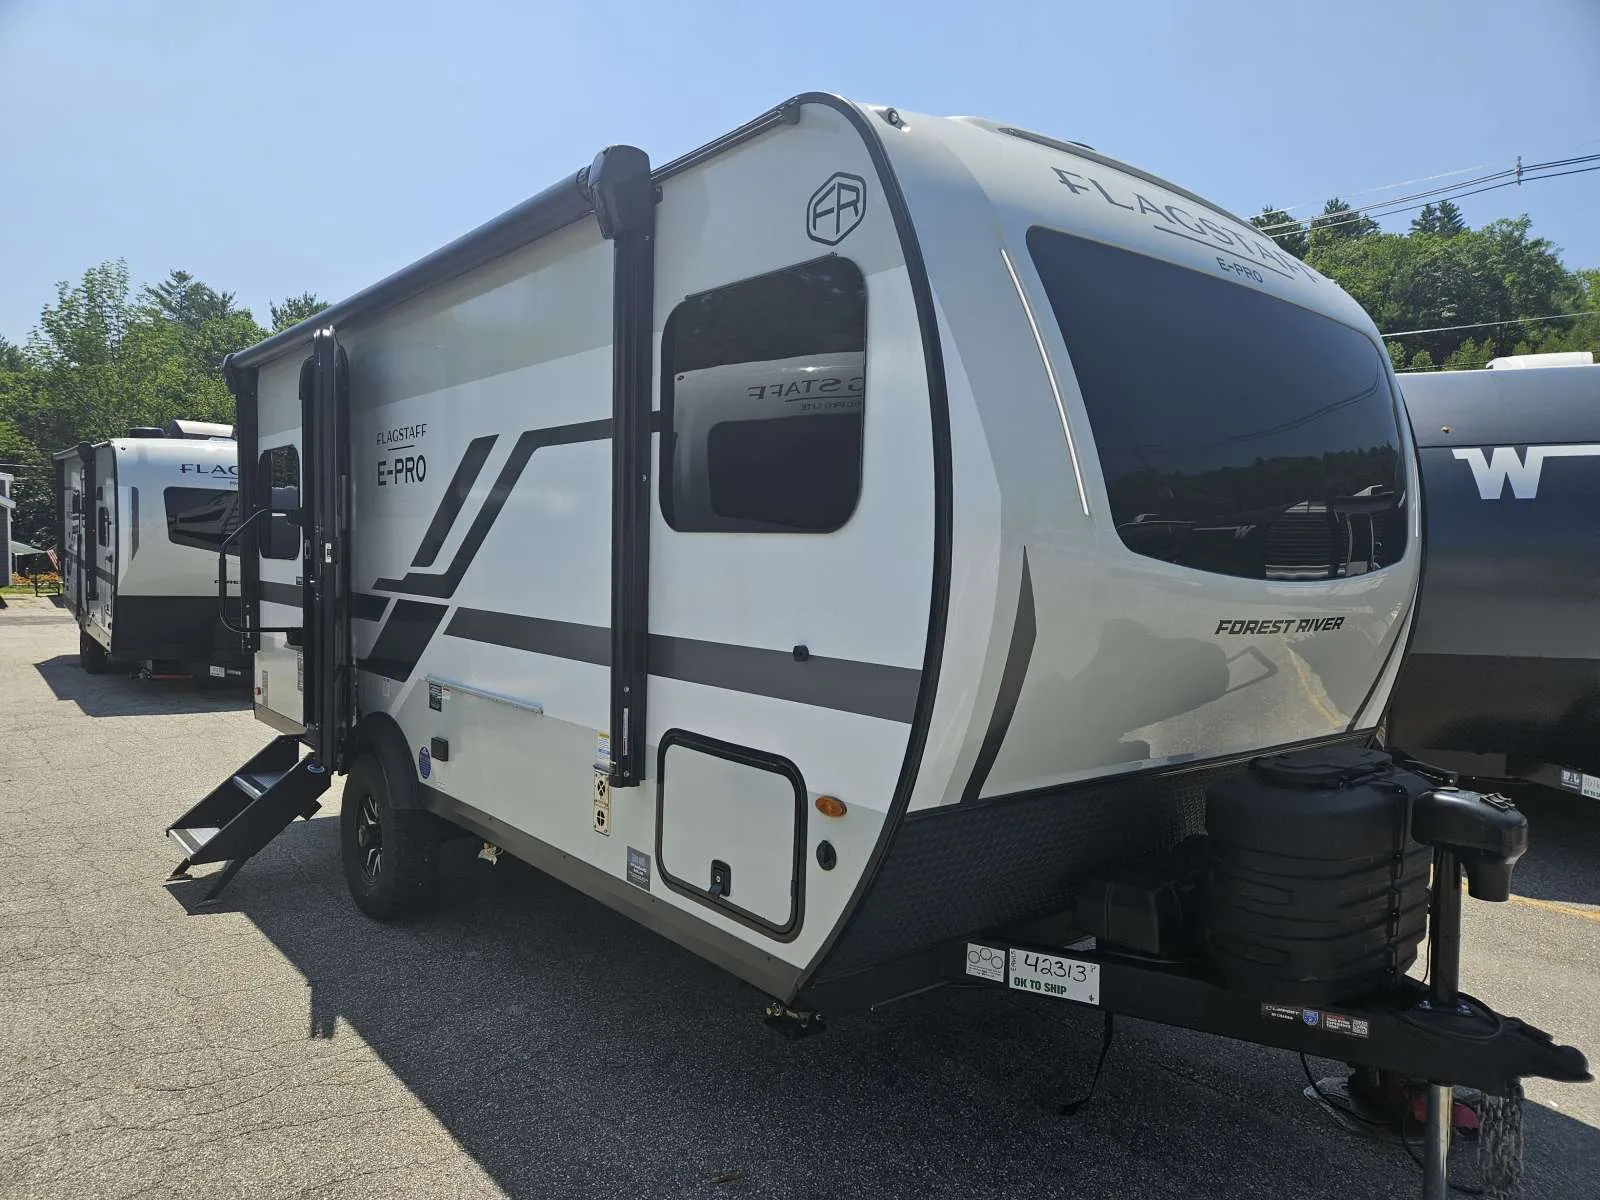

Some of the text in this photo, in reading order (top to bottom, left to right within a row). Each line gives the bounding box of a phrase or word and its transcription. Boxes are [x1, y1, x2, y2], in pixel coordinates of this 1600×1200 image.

[1216, 256, 1264, 284] E-PRO
[376, 423, 428, 446] FLAGSTAFF
[377, 454, 427, 487] E-PRO
[1214, 616, 1345, 635] FOREST RIVER
[1024, 953, 1087, 983] 42313
[1013, 976, 1067, 996] OK TO SHIP
